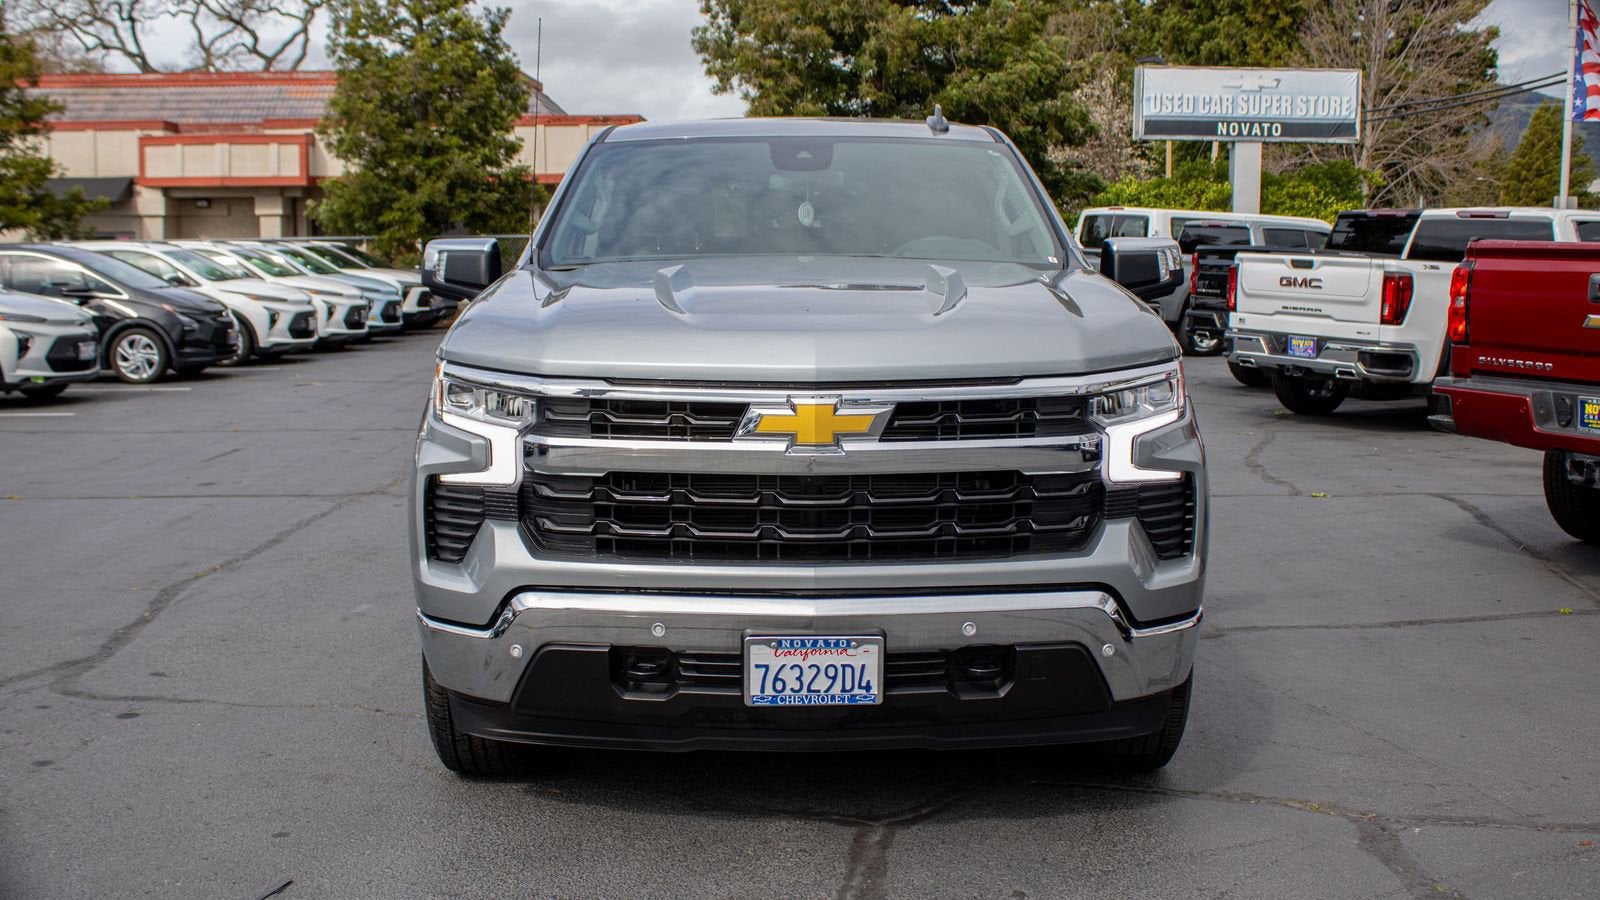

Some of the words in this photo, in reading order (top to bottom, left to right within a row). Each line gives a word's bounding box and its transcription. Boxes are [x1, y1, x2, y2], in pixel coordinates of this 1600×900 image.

[1152, 93, 1194, 113] USED
[1198, 94, 1233, 114] CAR
[1238, 94, 1292, 115] SUPER
[1296, 95, 1351, 116] STORE
[1217, 121, 1281, 136] NOVATO
[1280, 276, 1322, 289] GMC
[1478, 356, 1553, 371] SILVERADO
[1585, 402, 1600, 415] NO
[781, 639, 847, 648] NOVATO
[754, 663, 872, 694] 76329D4
[777, 695, 850, 704] CHEVROLET
